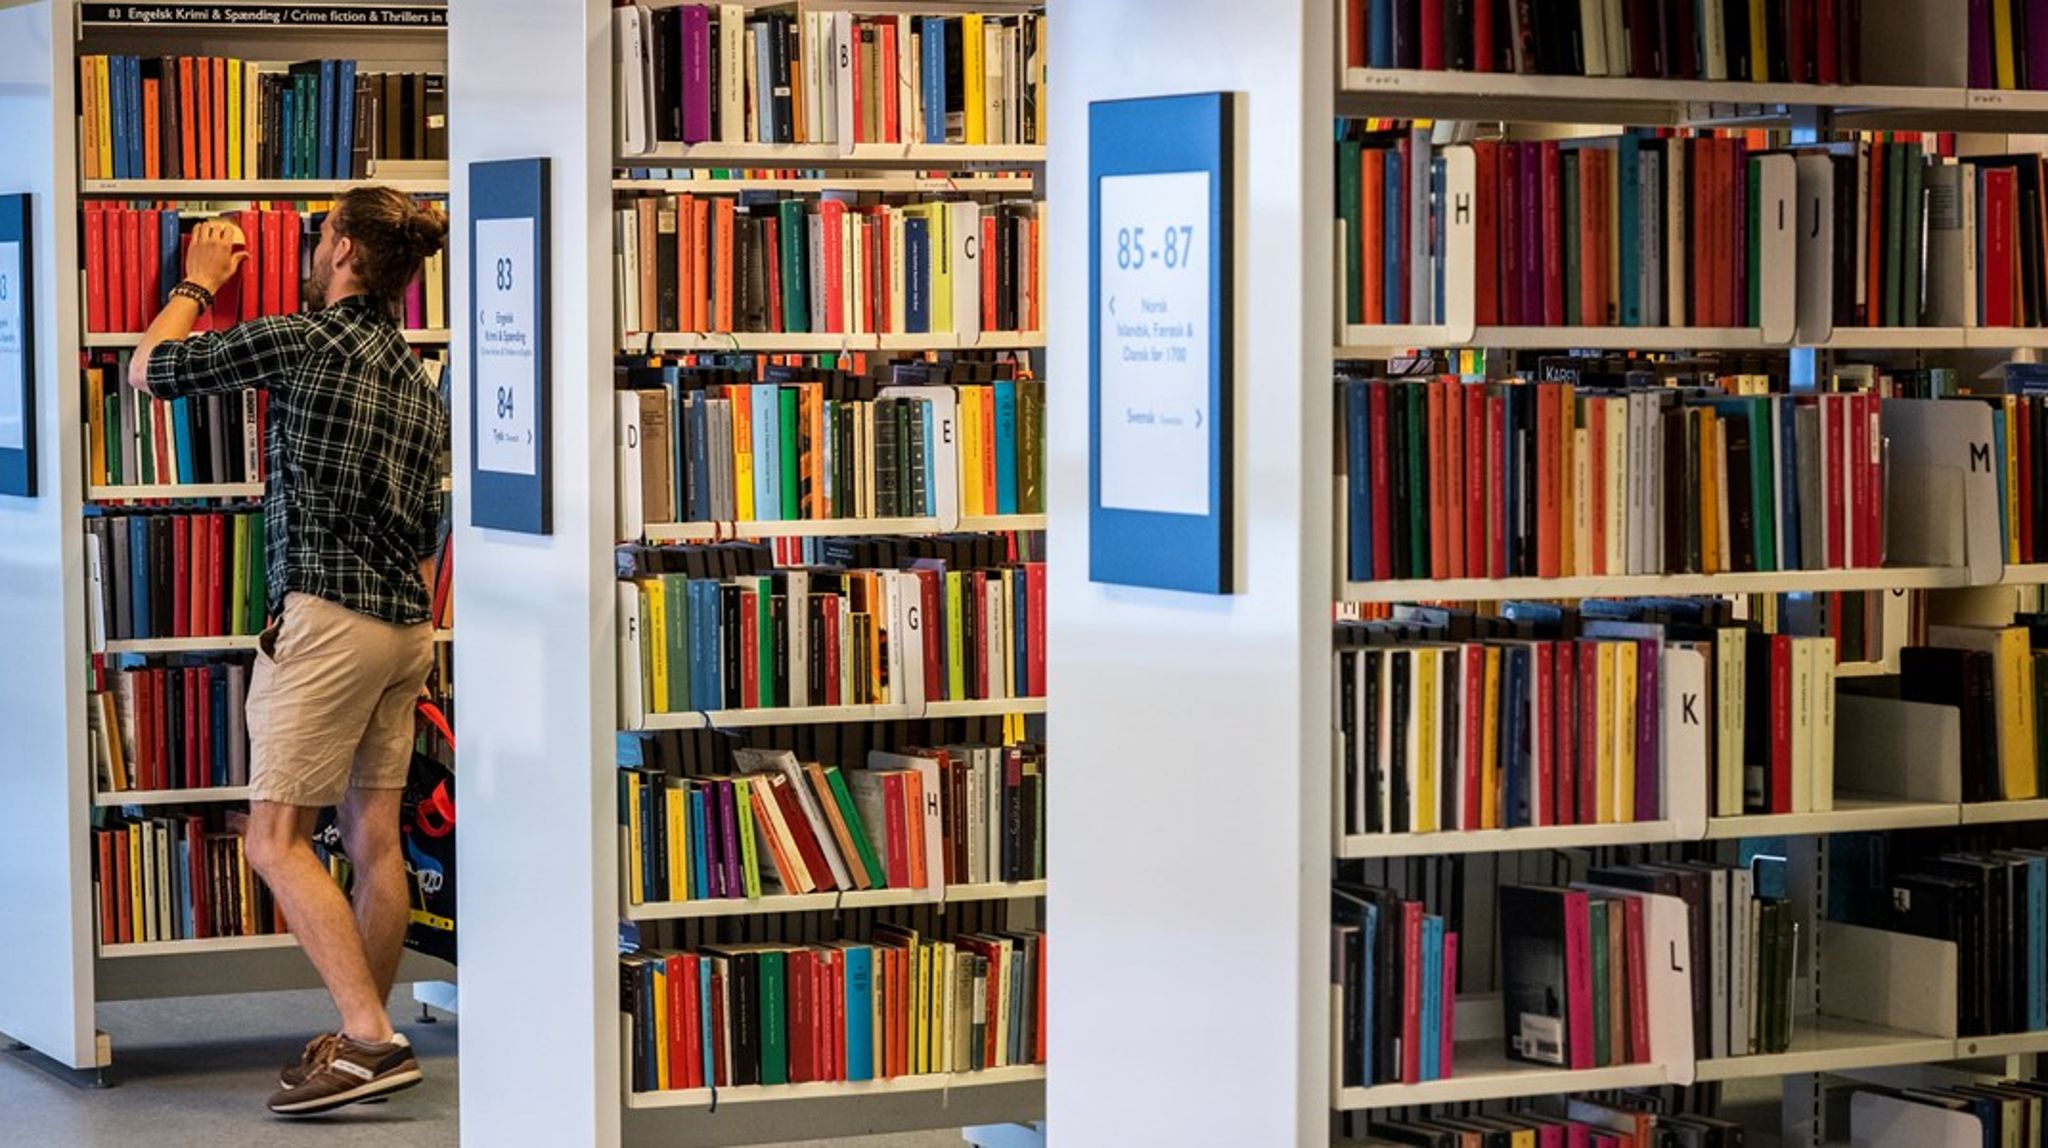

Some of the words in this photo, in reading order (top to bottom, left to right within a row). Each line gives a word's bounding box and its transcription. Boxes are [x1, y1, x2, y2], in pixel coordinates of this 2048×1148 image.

[128, 8, 173, 23] Engelsk
[175, 8, 209, 20] Krimi
[211, 9, 222, 20] &
[224, 9, 280, 23] Spænding
[291, 10, 327, 21] Crime
[330, 10, 366, 22] fiction
[368, 11, 378, 22] &
[380, 11, 429, 22] Thrillers
[431, 12, 442, 22] in
[840, 44, 849, 68] B
[1455, 192, 1470, 225] H
[1778, 199, 1784, 231] I
[1811, 197, 1820, 239] J
[964, 235, 976, 260] C
[1117, 226, 1145, 270] 85
[1164, 225, 1193, 269] 87
[0, 274, 7, 300] 3
[496, 257, 512, 291] 83
[497, 386, 513, 418] 84
[627, 424, 638, 449] D
[943, 420, 951, 443] E
[1969, 441, 1991, 473] M
[629, 617, 636, 641] F
[908, 606, 919, 630] G
[1682, 693, 1699, 725] K
[927, 792, 938, 817] H
[1670, 940, 1684, 973] L
